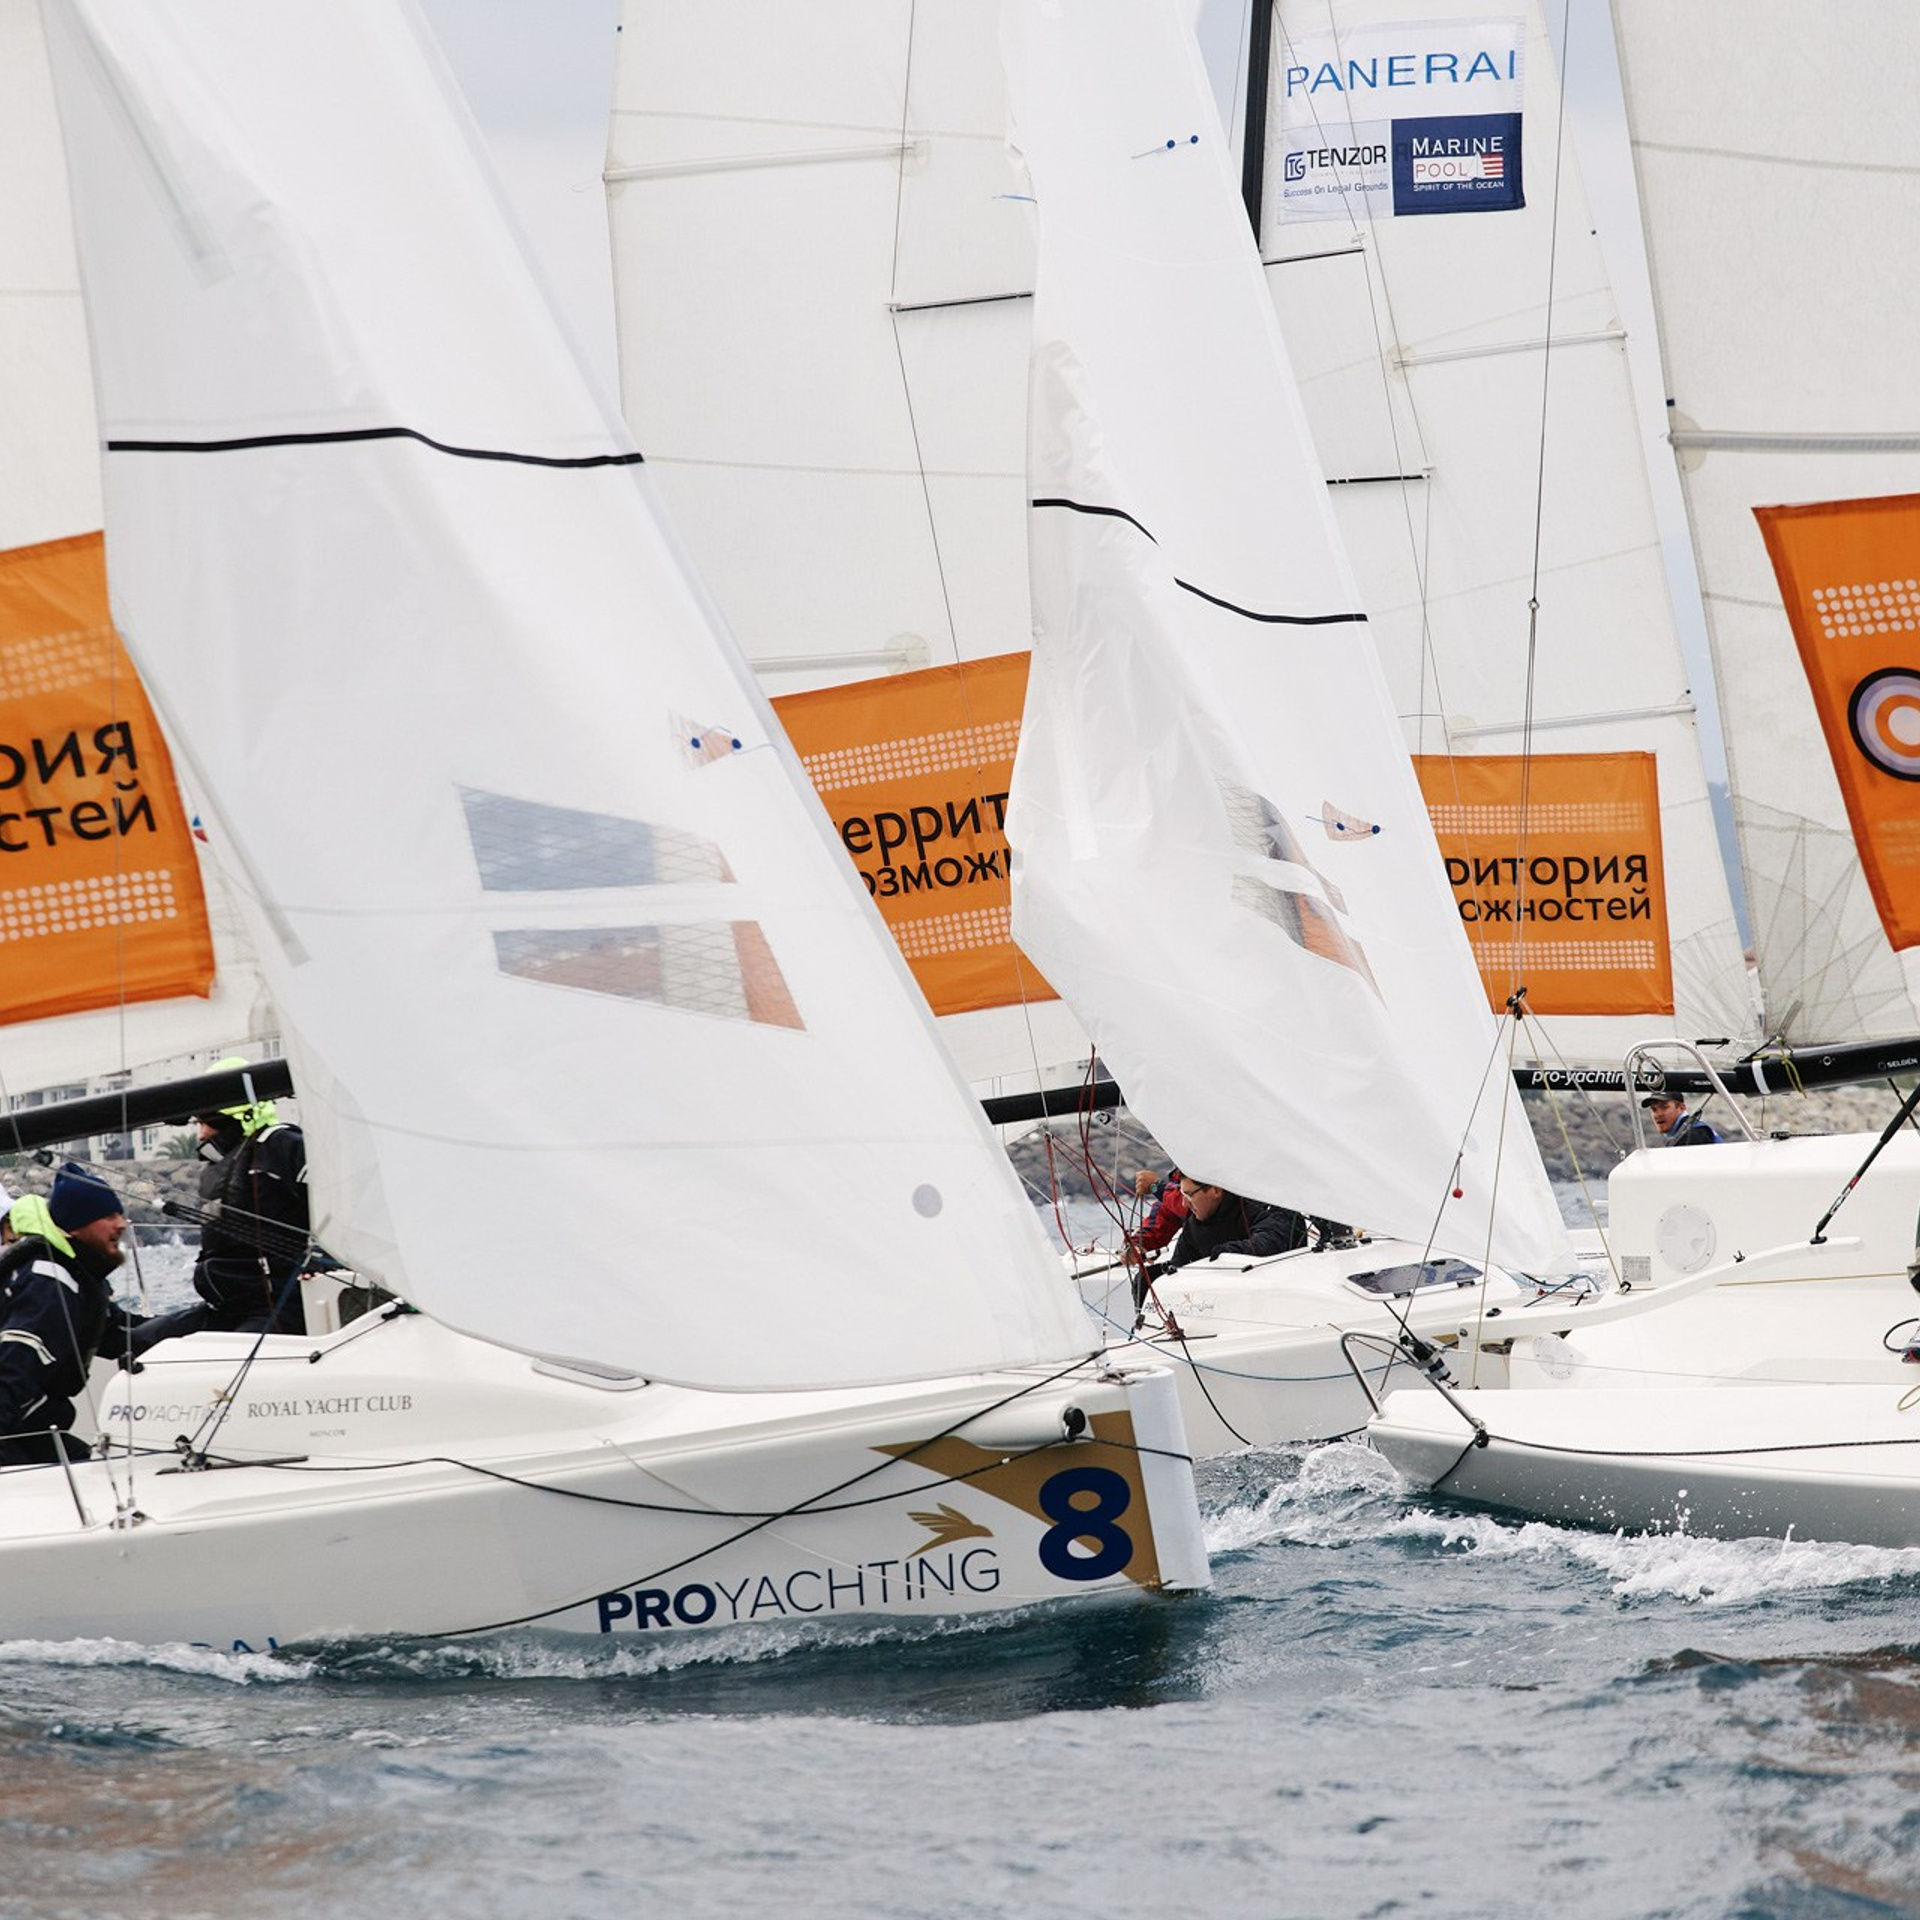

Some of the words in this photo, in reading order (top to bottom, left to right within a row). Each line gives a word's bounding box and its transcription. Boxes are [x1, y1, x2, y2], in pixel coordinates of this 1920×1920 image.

[1287, 49, 1516, 97] PANERAI
[1306, 145, 1387, 169] TENZOR
[1412, 136, 1503, 156] MARINE
[1415, 161, 1468, 178] POOL
[1283, 188, 1313, 198] Success
[1314, 185, 1326, 195] On
[1327, 183, 1352, 194] Legal
[1354, 182, 1389, 192] Grounds
[1413, 183, 1440, 192] SPIRIT
[1442, 183, 1455, 191] OF
[1457, 182, 1474, 190] THE
[1475, 181, 1505, 190] OCEAN
[833, 792, 1009, 866] еррит
[1458, 887, 1651, 922] ожностей
[1532, 1069, 1660, 1086] pro-yachtin.ru
[108, 1404, 230, 1423] PROYACHTG
[248, 1401, 301, 1418] ROYAL
[305, 1397, 362, 1415] YACHT
[367, 1395, 412, 1412] CLUB
[1038, 1466, 1134, 1581] 8
[599, 1548, 1000, 1633] PROYACHTING
